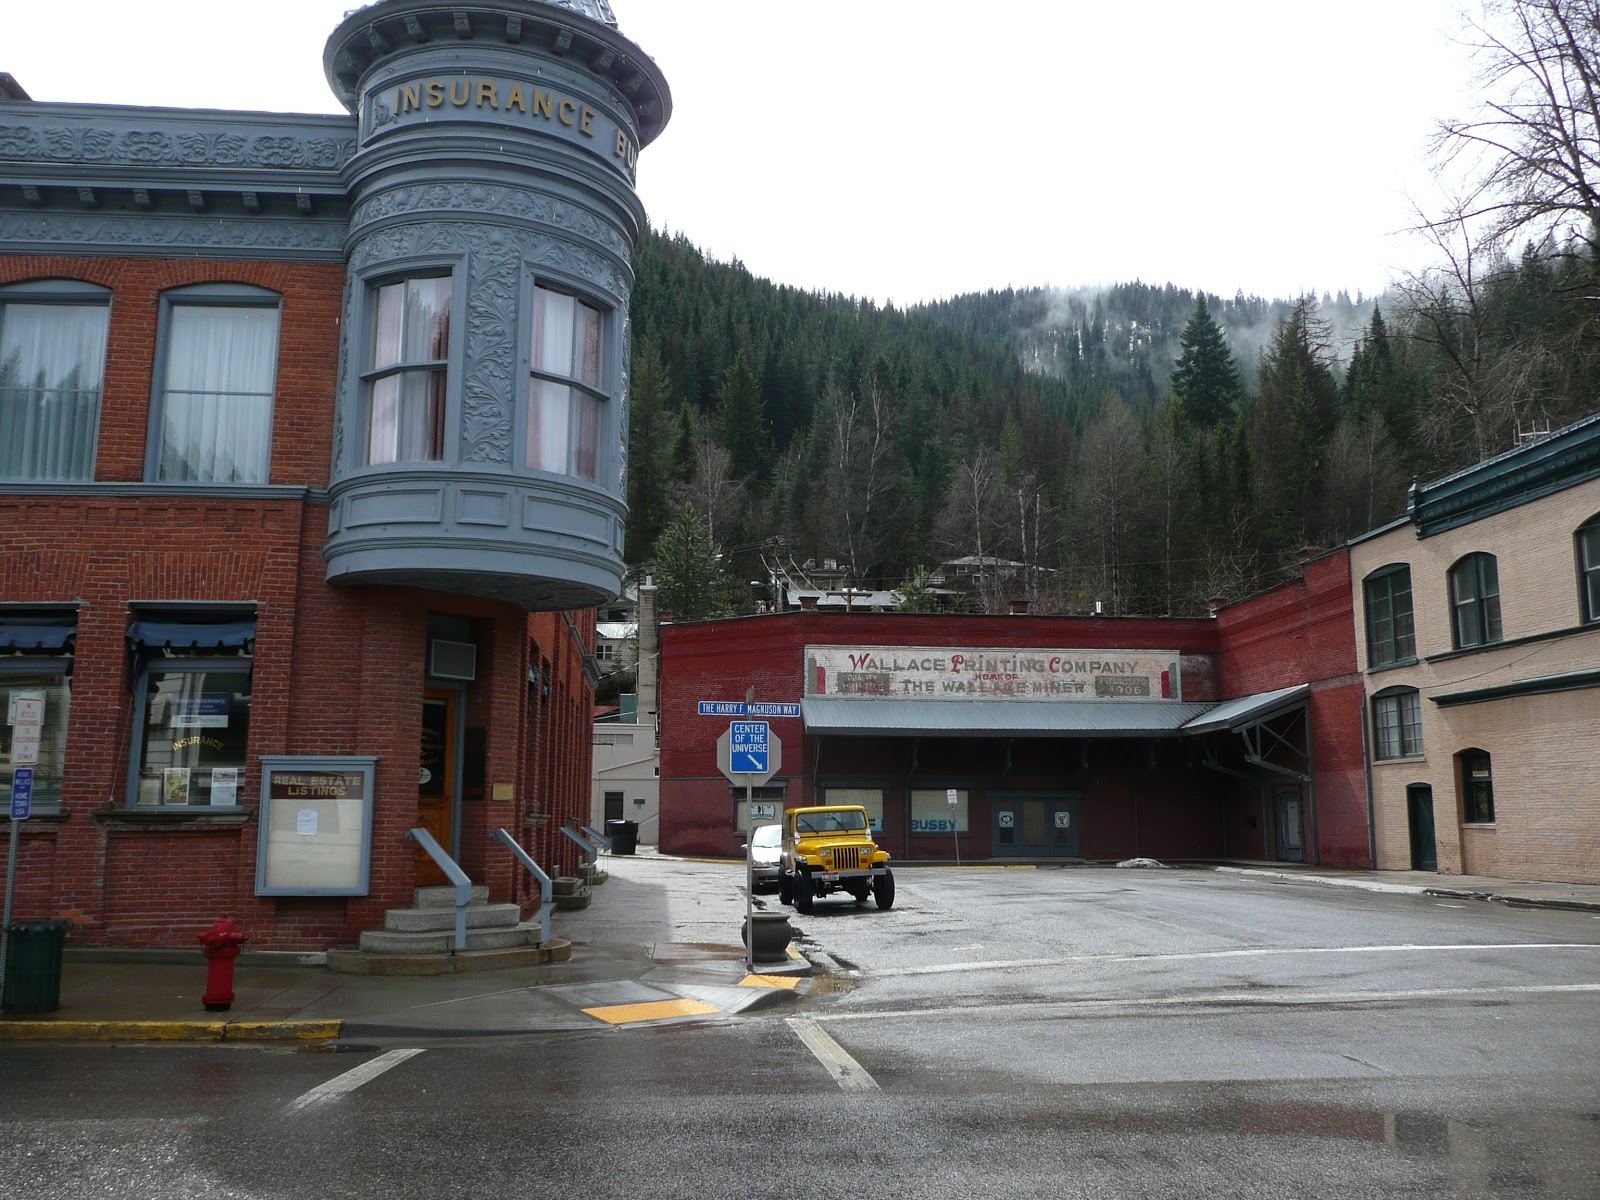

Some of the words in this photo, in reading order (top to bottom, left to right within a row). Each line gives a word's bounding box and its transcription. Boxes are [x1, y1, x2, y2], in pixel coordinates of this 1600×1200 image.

[392, 79, 598, 138] INSURANCE
[848, 653, 946, 672] WALLACE
[1048, 656, 1139, 674] COMPANY
[974, 673, 1003, 681] HOME
[1005, 673, 1020, 681] OF
[901, 679, 935, 693] THE
[1032, 681, 1086, 694] MINER
[702, 703, 714, 713] THE
[716, 703, 737, 714] HARRY
[747, 704, 781, 715] MAGNUSON
[783, 705, 797, 715] WAY
[734, 724, 765, 734] CENTER
[172, 736, 225, 751] INSURANCE
[735, 734, 745, 743] OF
[750, 734, 765, 743] THE
[732, 743, 768, 753] UNIVERSE
[274, 776, 306, 786] REAL
[311, 776, 361, 786] ESTATE
[287, 786, 346, 796] LISTINGS
[911, 819, 957, 831] BUSBY
